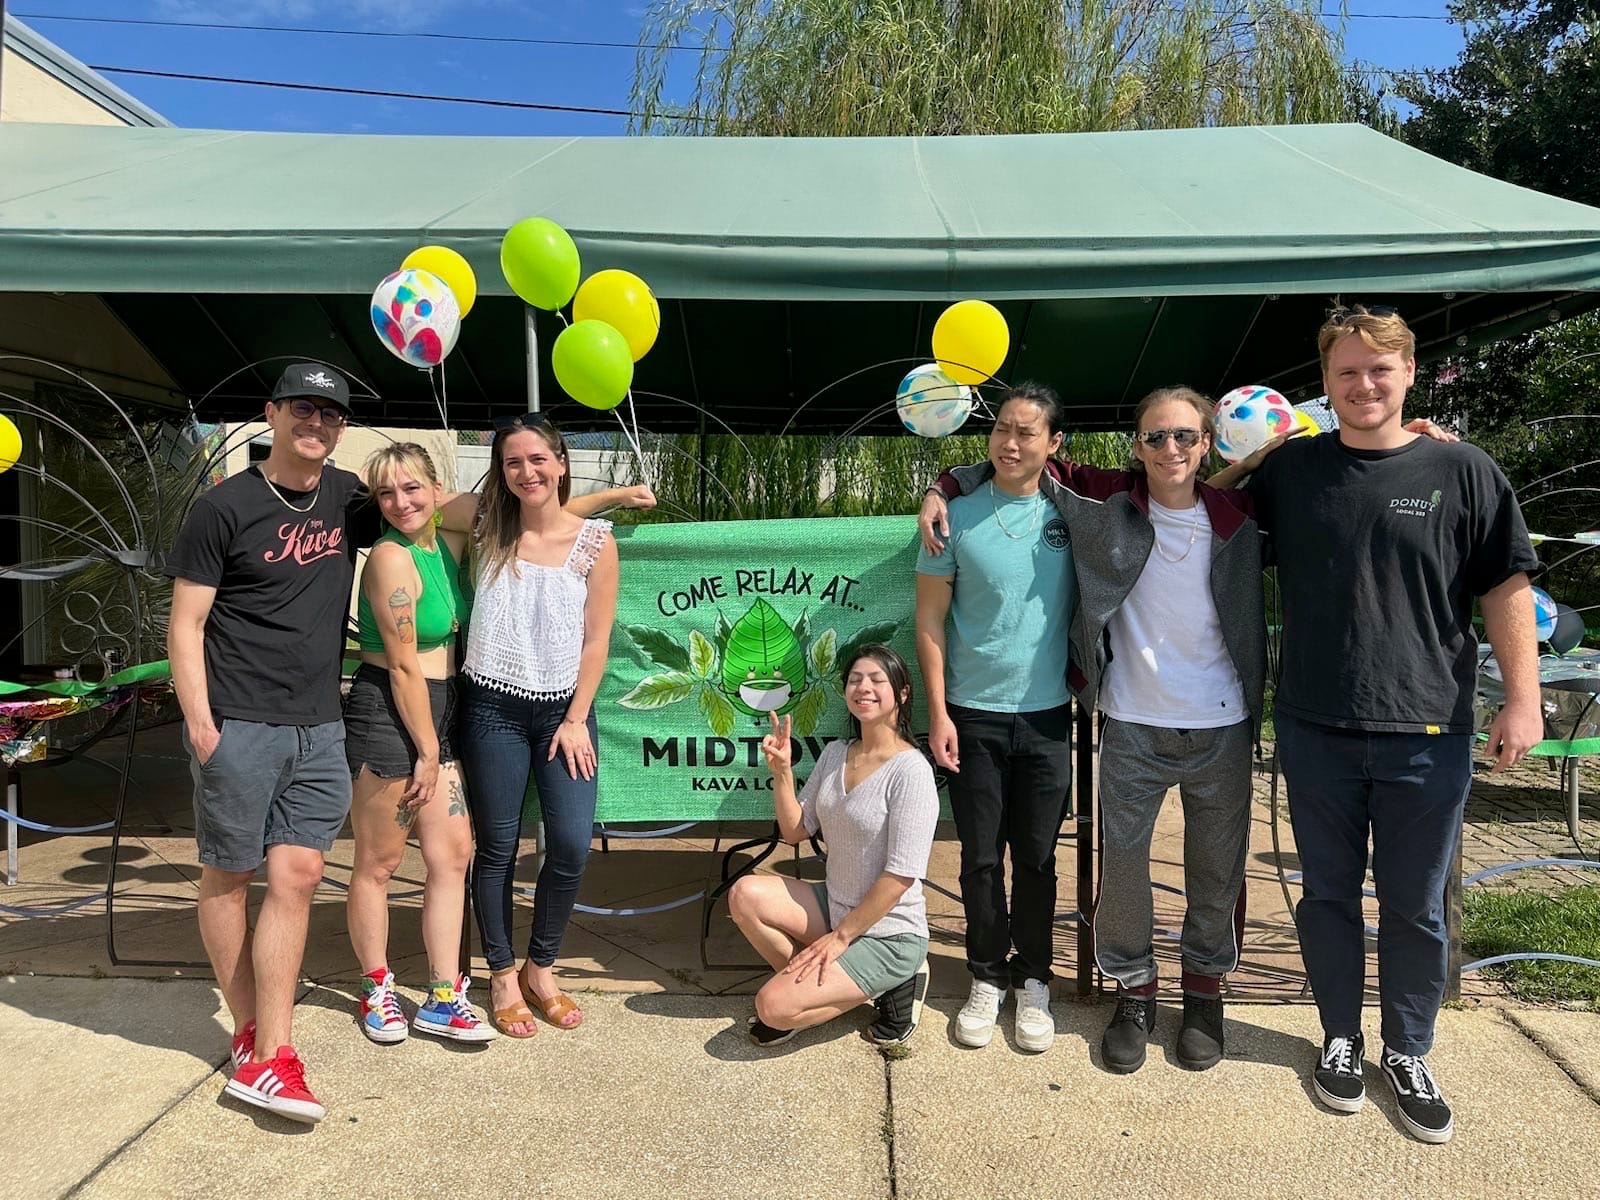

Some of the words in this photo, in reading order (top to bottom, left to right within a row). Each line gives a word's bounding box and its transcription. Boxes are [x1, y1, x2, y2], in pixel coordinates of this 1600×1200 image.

[1389, 498, 1436, 512] DONUT
[264, 518, 342, 565] Kava
[657, 576, 727, 617] COME
[735, 566, 814, 597] RELAX
[642, 737, 839, 767] MIDT
[692, 777, 749, 791] KAVA
